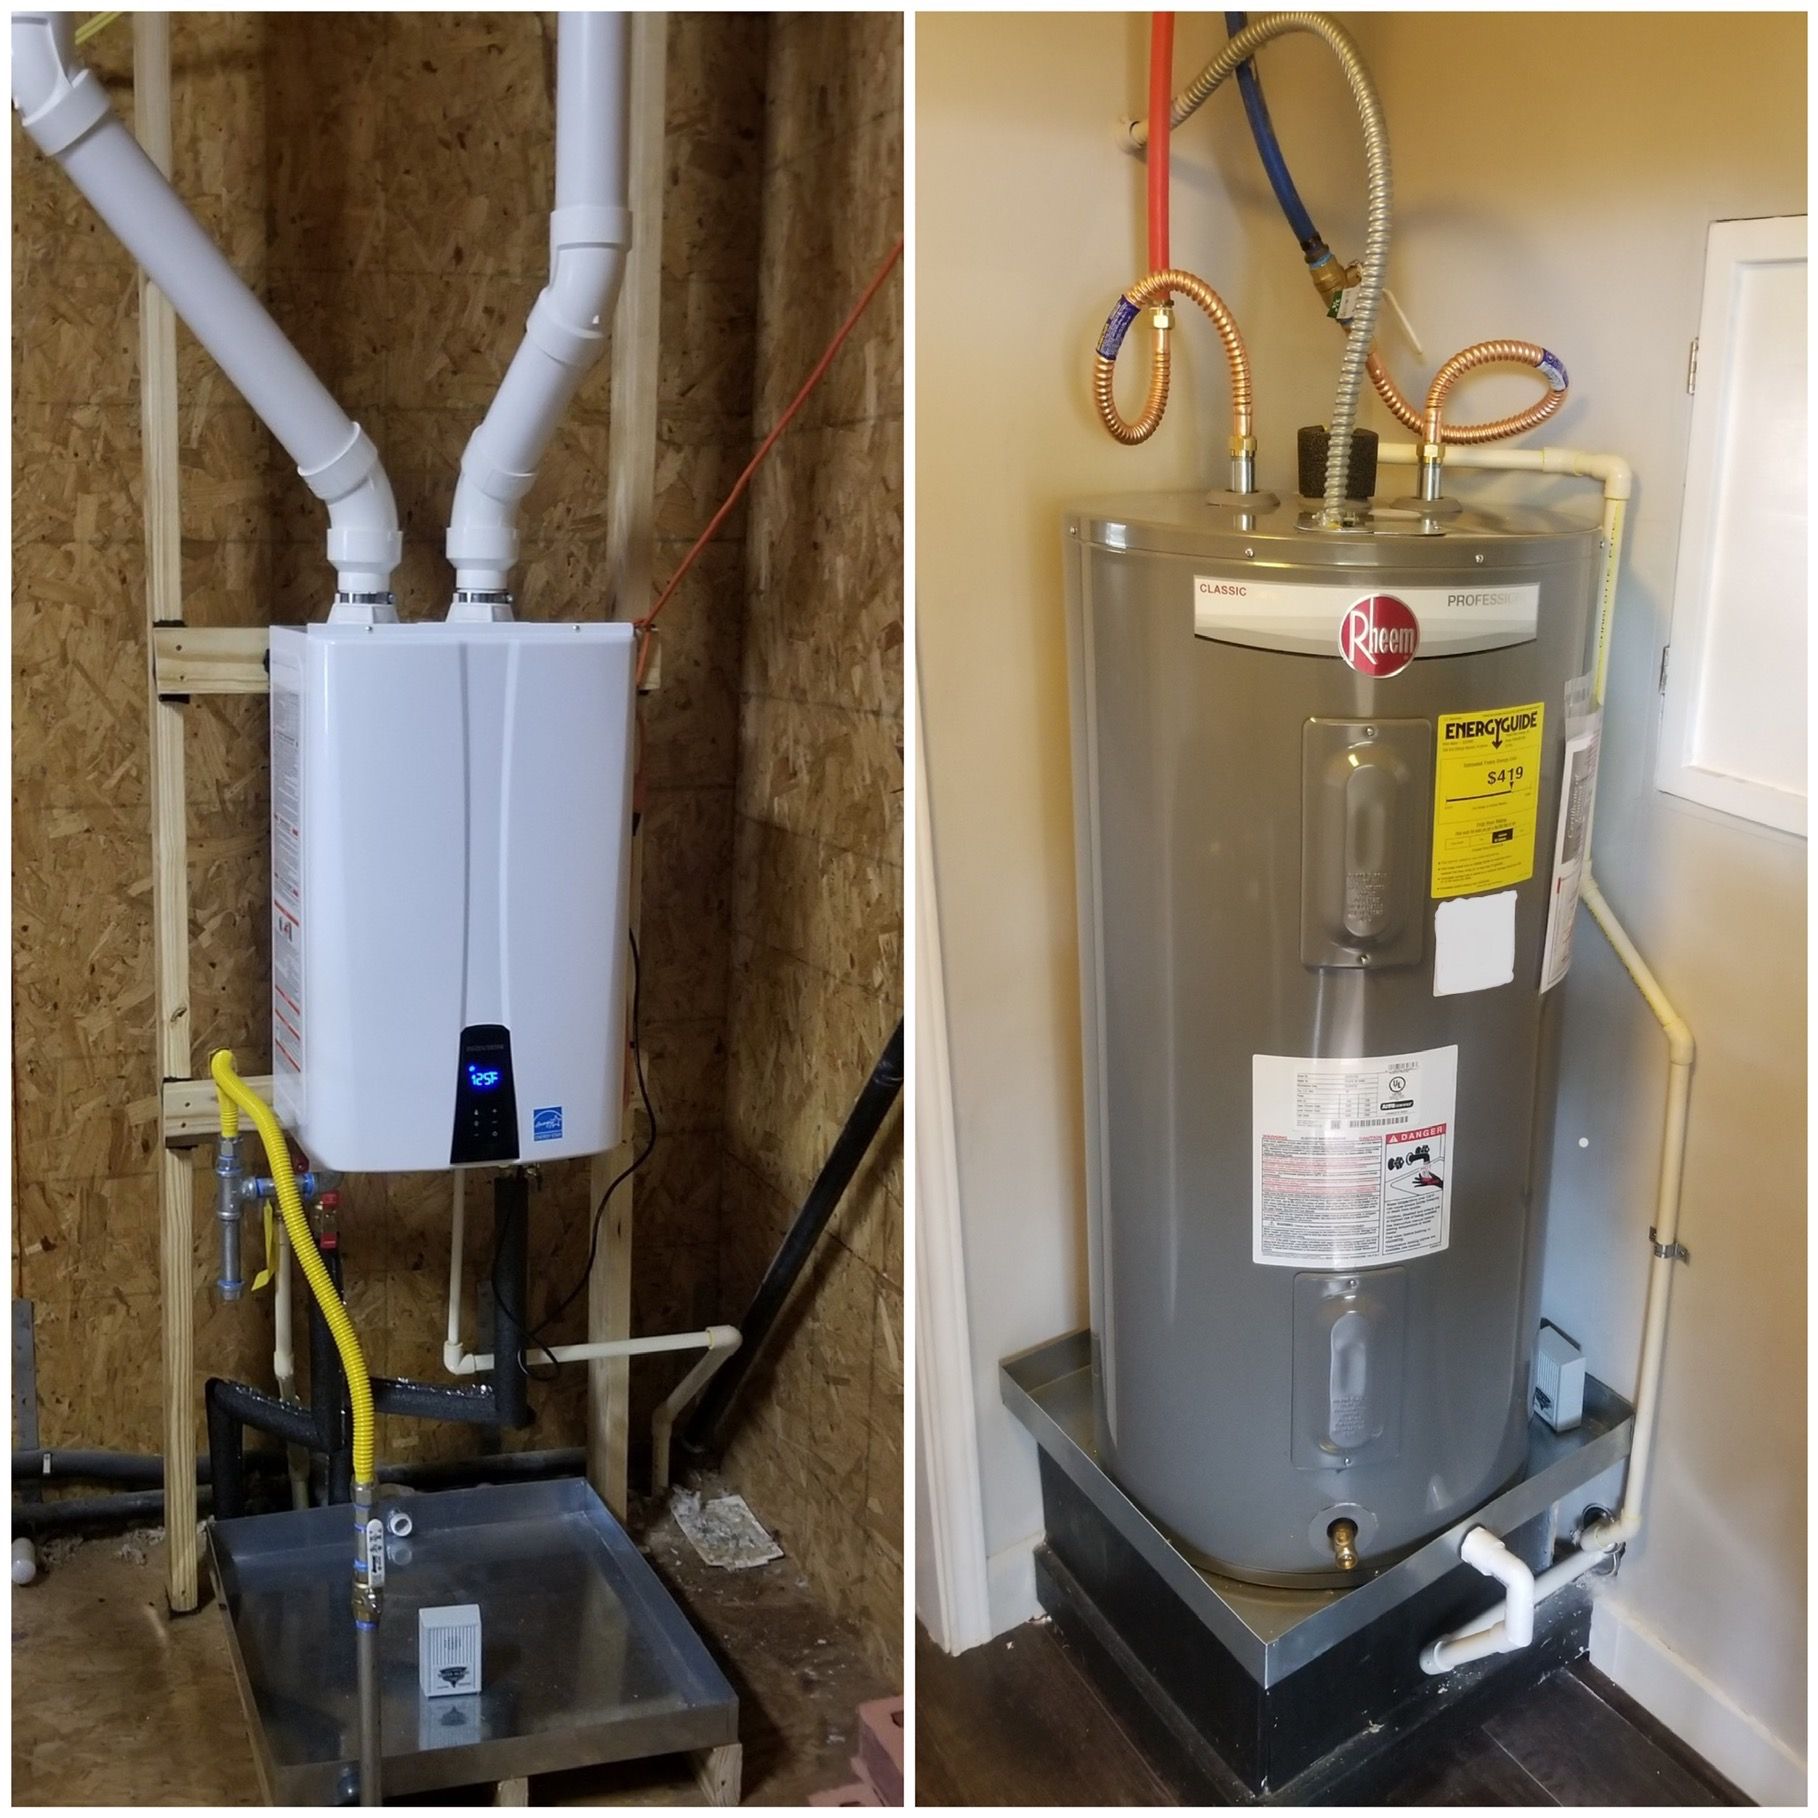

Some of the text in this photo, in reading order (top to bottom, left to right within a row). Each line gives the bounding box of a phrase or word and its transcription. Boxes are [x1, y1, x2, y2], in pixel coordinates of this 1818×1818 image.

[1199, 583, 1248, 597] CLASSIC
[1348, 597, 1415, 665] Rheem
[1445, 711, 1538, 744] ENERGYGUIDE
[1487, 766, 1524, 785] $419
[471, 1071, 499, 1086] 125F
[1401, 1126, 1443, 1141] DANGER
